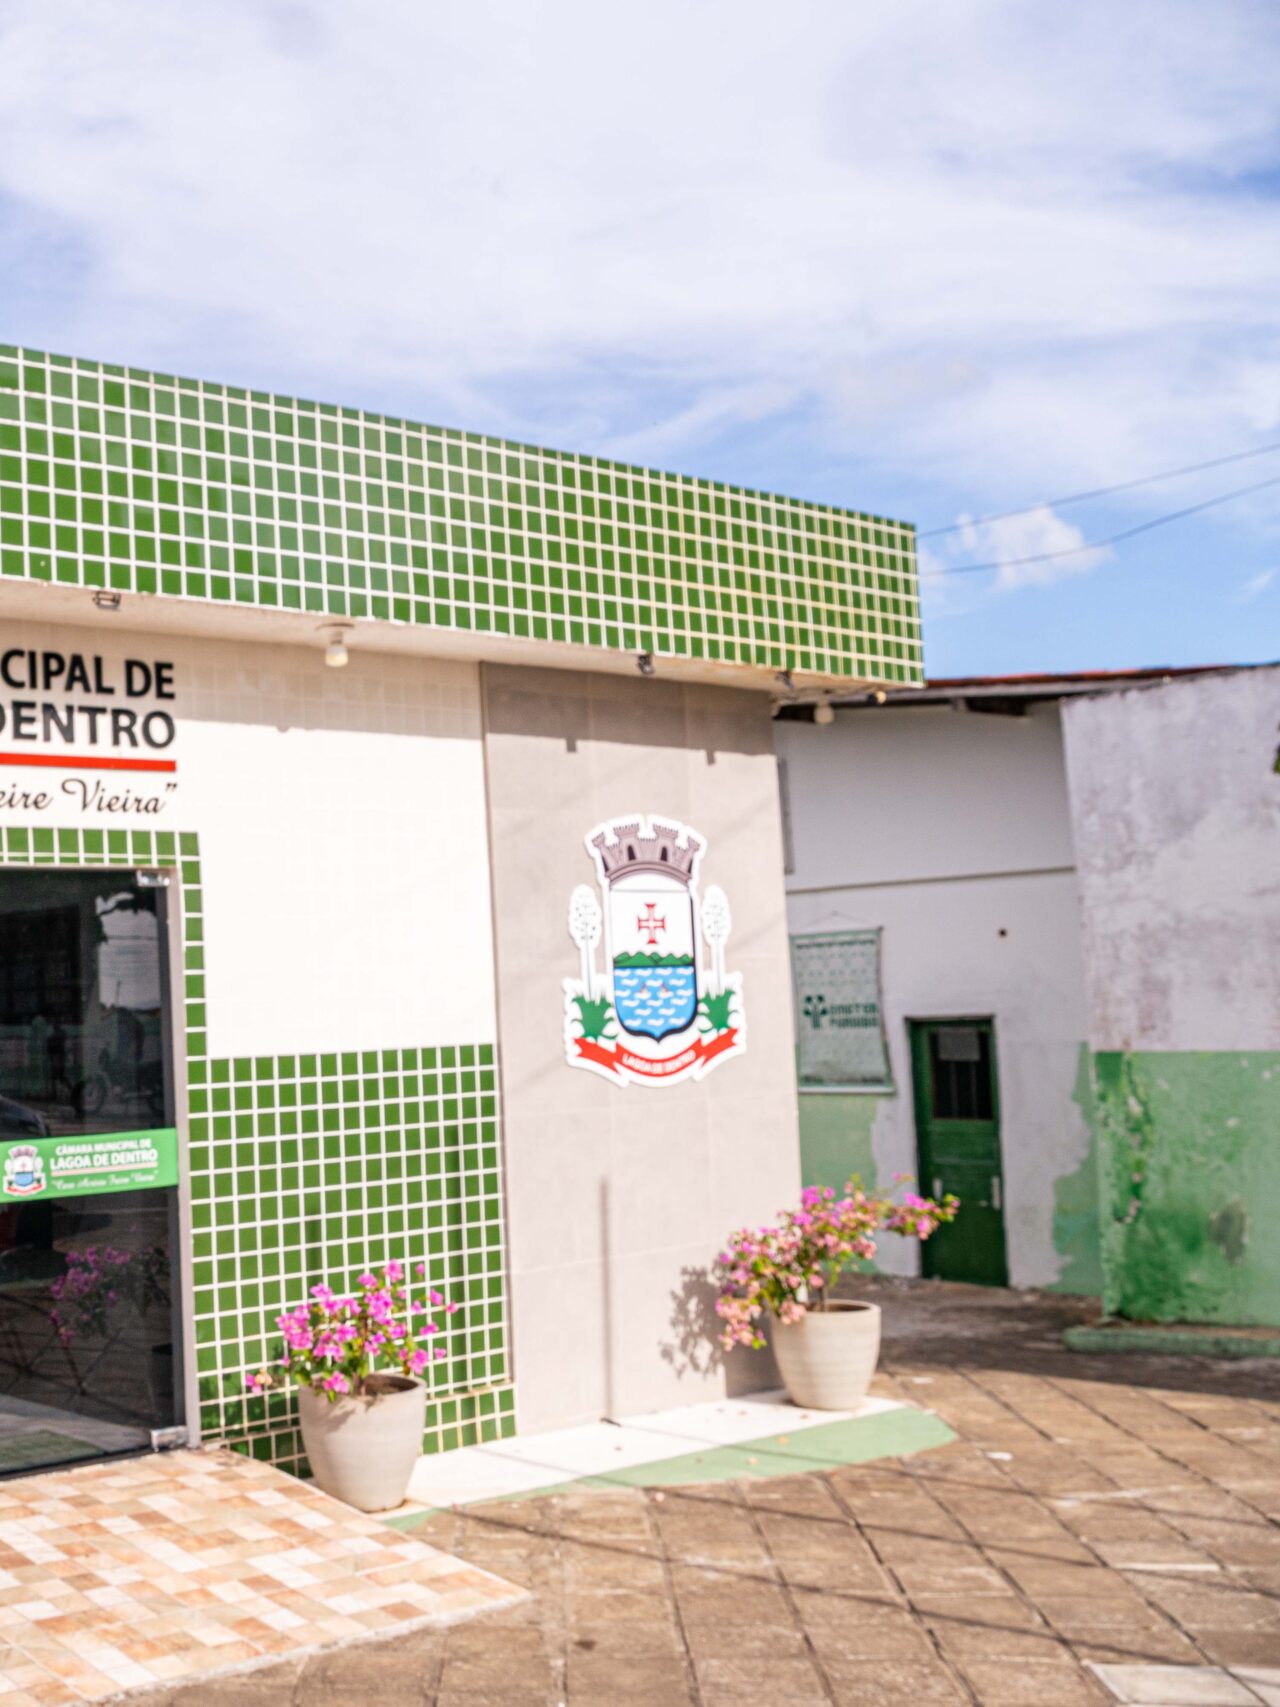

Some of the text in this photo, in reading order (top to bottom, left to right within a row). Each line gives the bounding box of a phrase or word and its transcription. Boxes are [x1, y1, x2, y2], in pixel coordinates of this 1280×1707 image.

[124, 660, 175, 699] DE
[50, 1148, 159, 1170] LAGOA DE DENTRO
